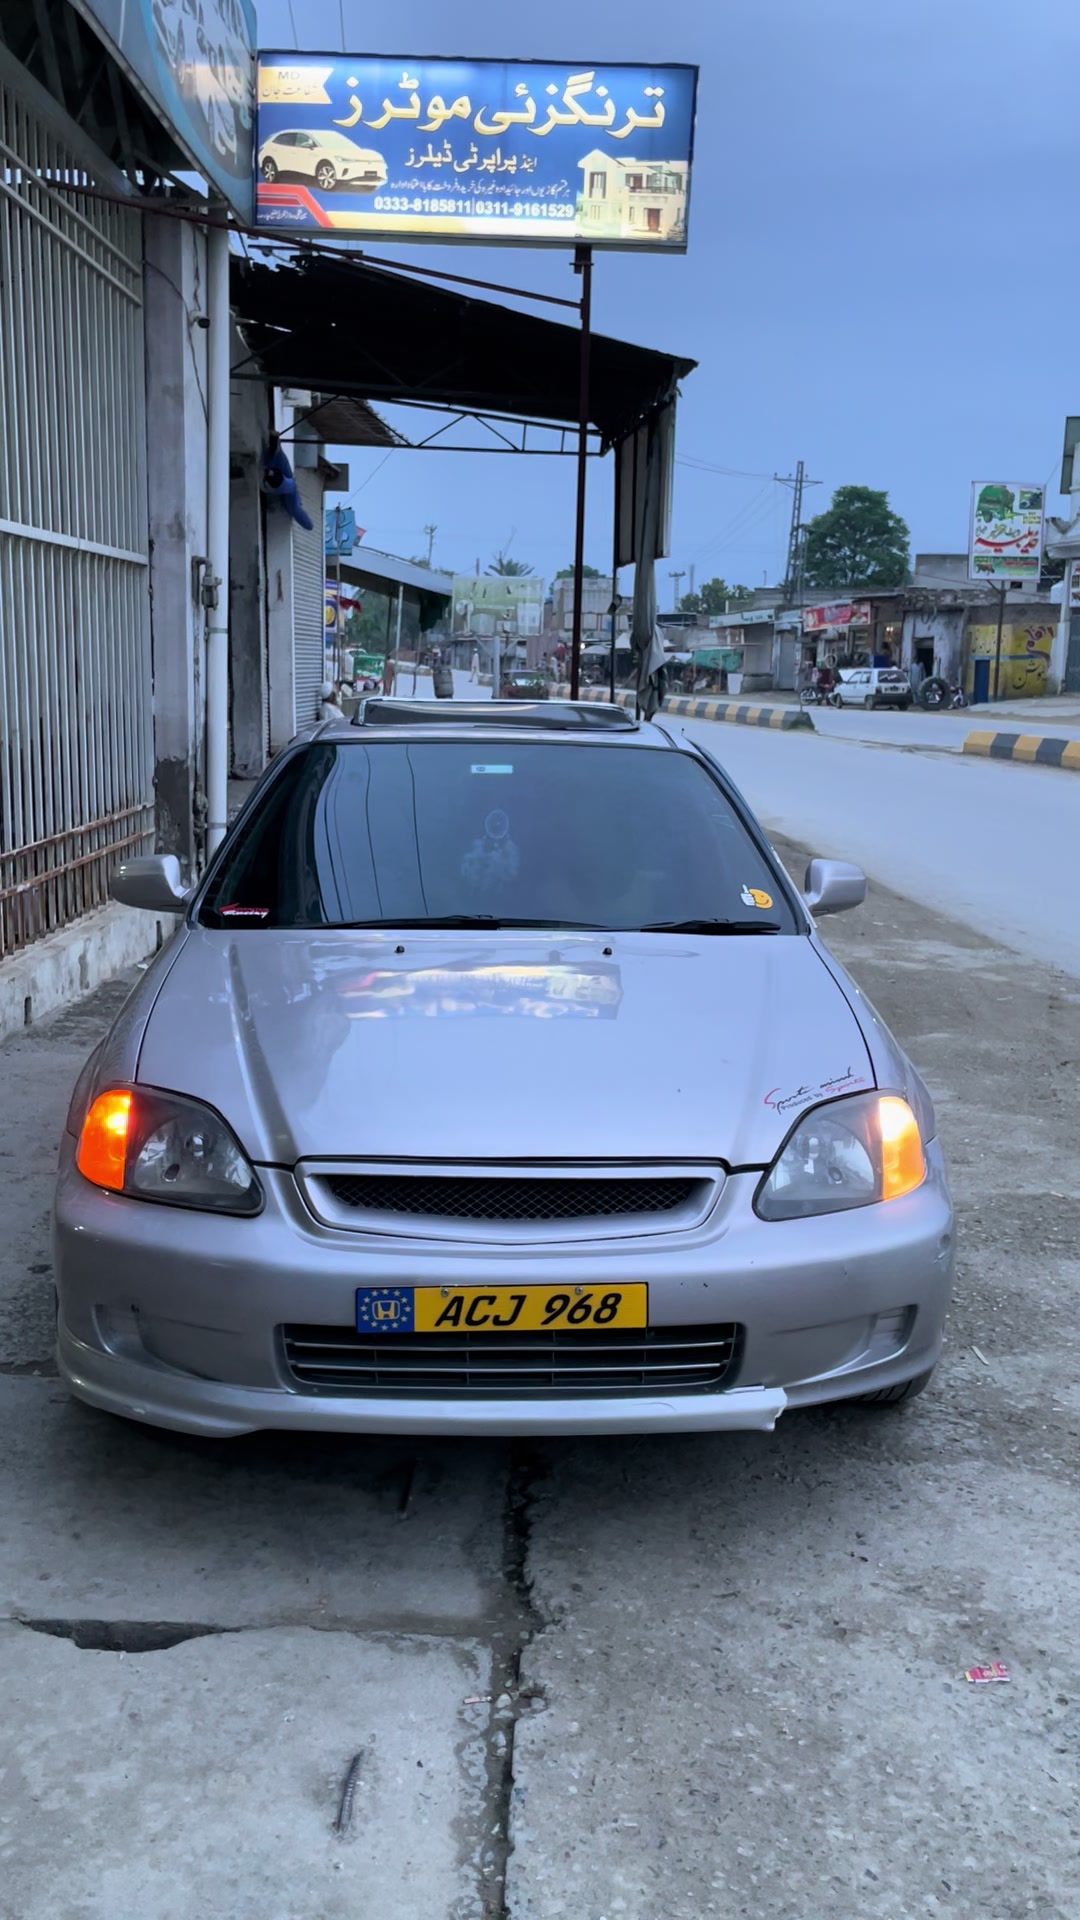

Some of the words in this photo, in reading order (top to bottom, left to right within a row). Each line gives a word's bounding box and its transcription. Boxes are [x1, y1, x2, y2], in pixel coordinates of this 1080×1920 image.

[332, 71, 472, 132] موٹرز
[404, 139, 453, 168] ڈیلرز
[453, 141, 517, 174] پراپرٹی
[374, 196, 471, 214] 0333-8185811
[475, 200, 575, 218] 0311-9161529
[434, 1294, 528, 1327] ACJ
[540, 1293, 623, 1325] 968
